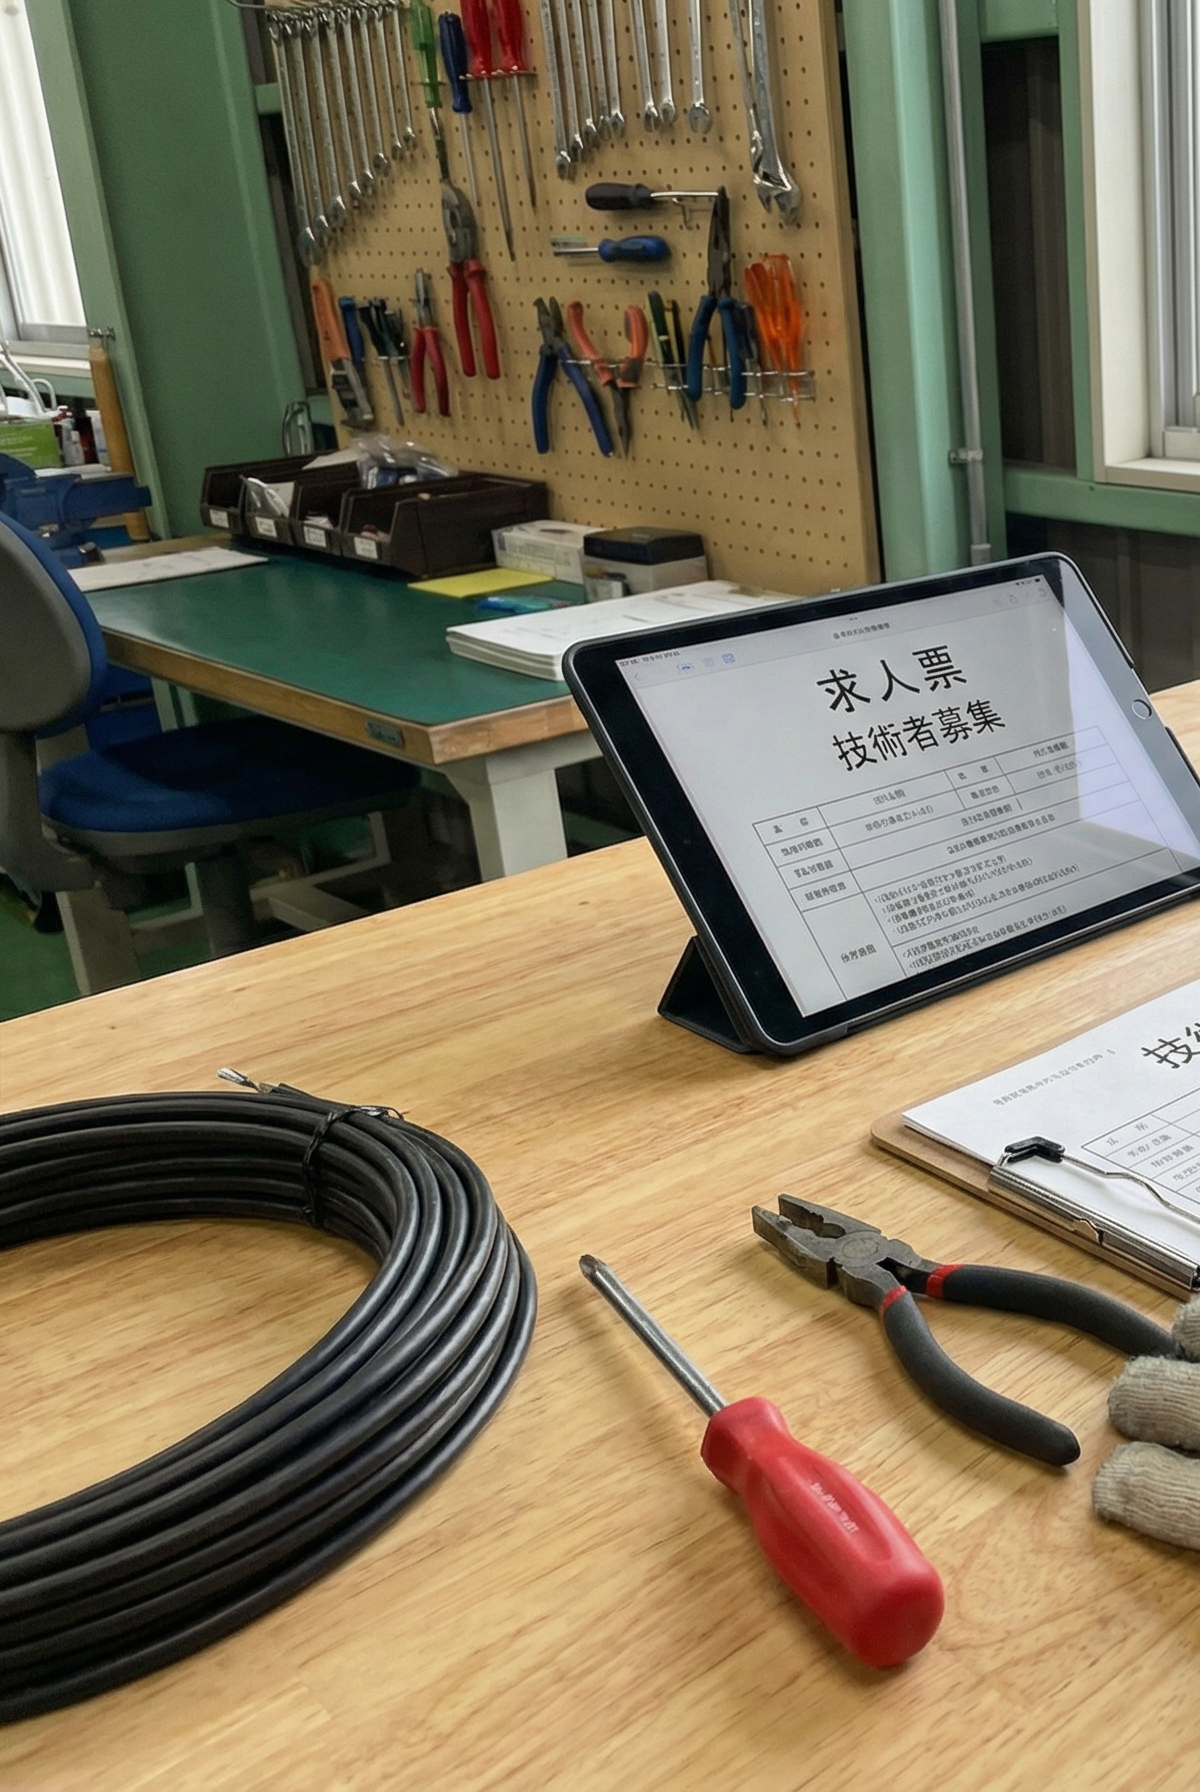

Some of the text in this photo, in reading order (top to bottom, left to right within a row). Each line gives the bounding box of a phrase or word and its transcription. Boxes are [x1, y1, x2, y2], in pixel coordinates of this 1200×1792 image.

[816, 645, 967, 713] 求人票
[832, 699, 1006, 771] 技術者募集
